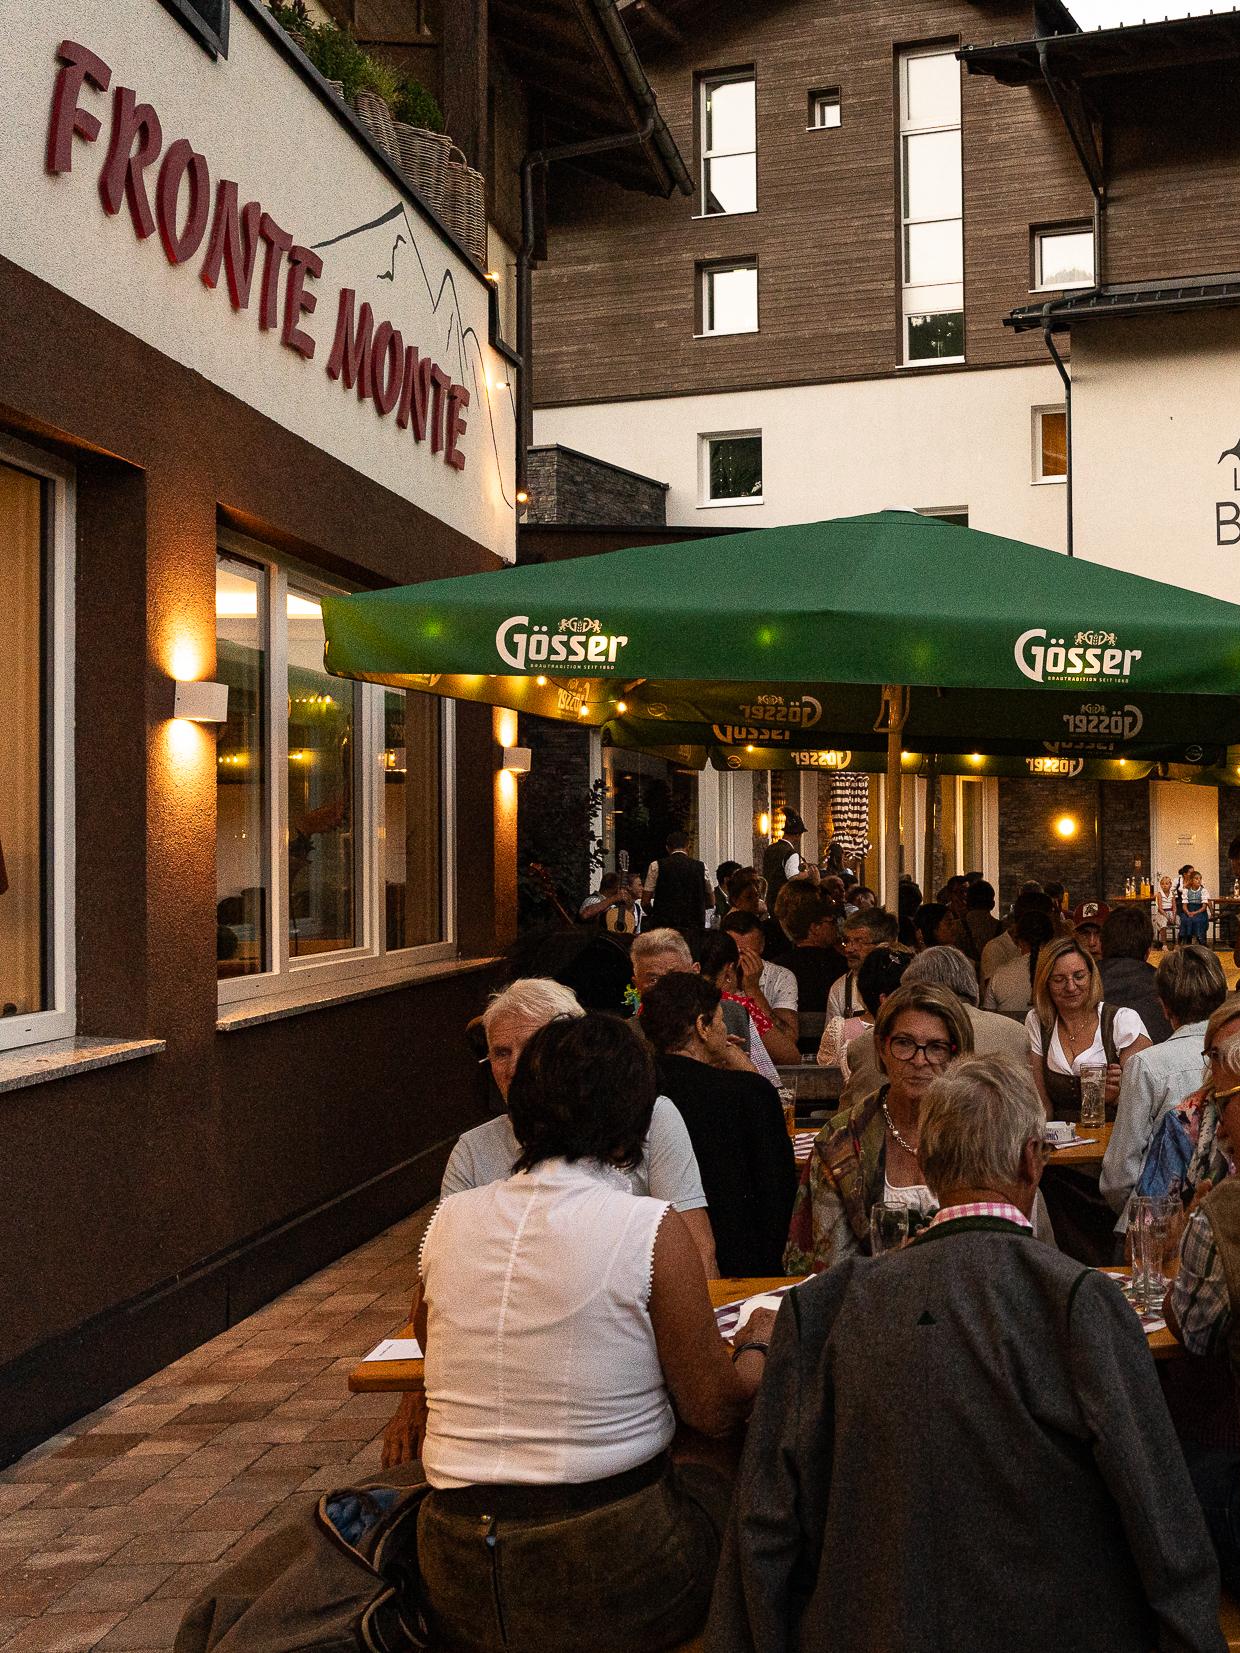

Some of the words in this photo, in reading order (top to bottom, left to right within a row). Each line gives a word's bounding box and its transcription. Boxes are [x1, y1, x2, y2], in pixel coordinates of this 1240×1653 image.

[46, 39, 324, 361] FRONTE
[326, 286, 471, 471] MONTE
[495, 615, 629, 670] Gösser
[1014, 628, 1142, 683] Gösser
